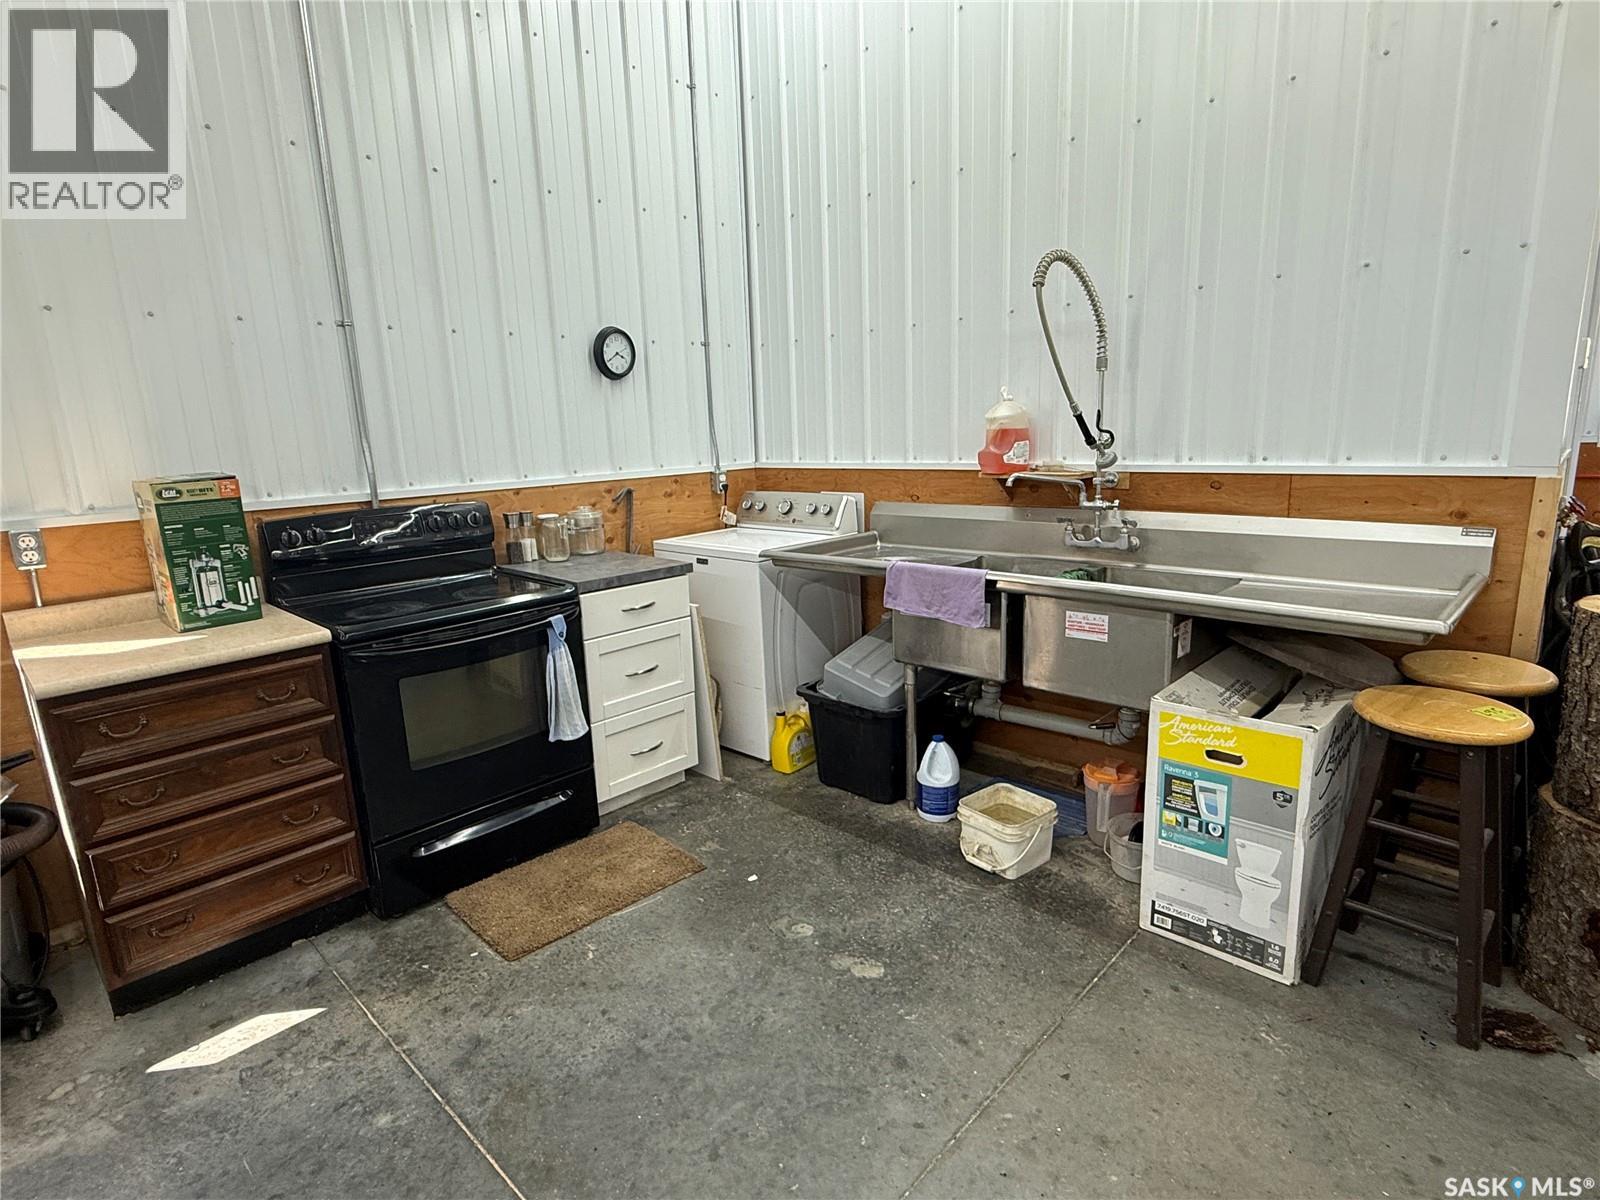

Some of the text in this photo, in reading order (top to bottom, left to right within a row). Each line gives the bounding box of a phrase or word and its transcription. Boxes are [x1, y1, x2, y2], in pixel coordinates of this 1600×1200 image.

[1159, 715, 1234, 733] American
[1163, 729, 1238, 748] Standard
[1164, 764, 1192, 777] Ravenna
